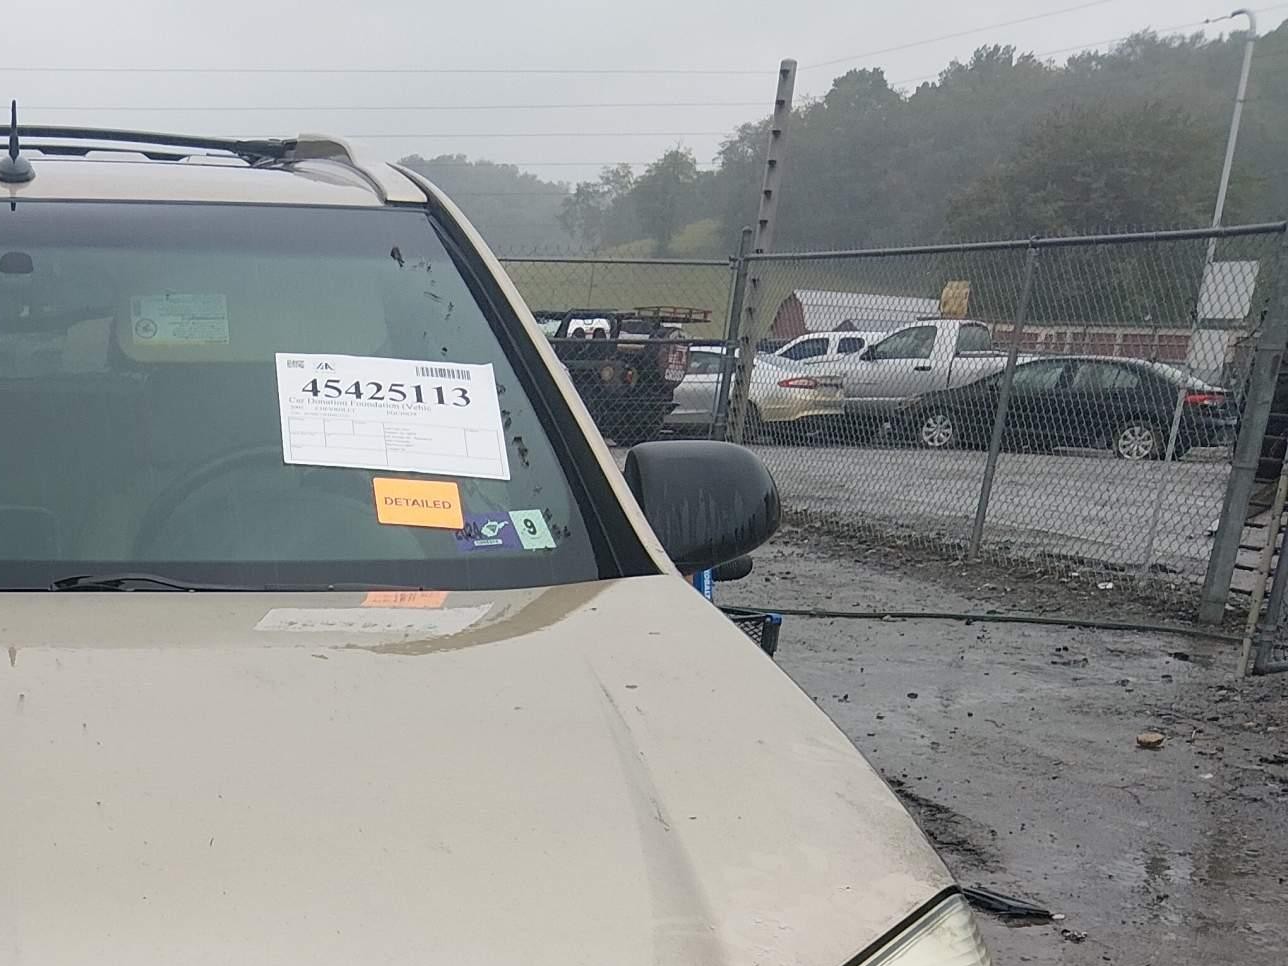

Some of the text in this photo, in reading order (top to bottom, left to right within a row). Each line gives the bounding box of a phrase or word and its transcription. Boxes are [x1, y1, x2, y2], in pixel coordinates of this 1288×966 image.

[302, 378, 471, 407] 45425113
[384, 496, 452, 510] DETAILED
[524, 518, 538, 536] 9
